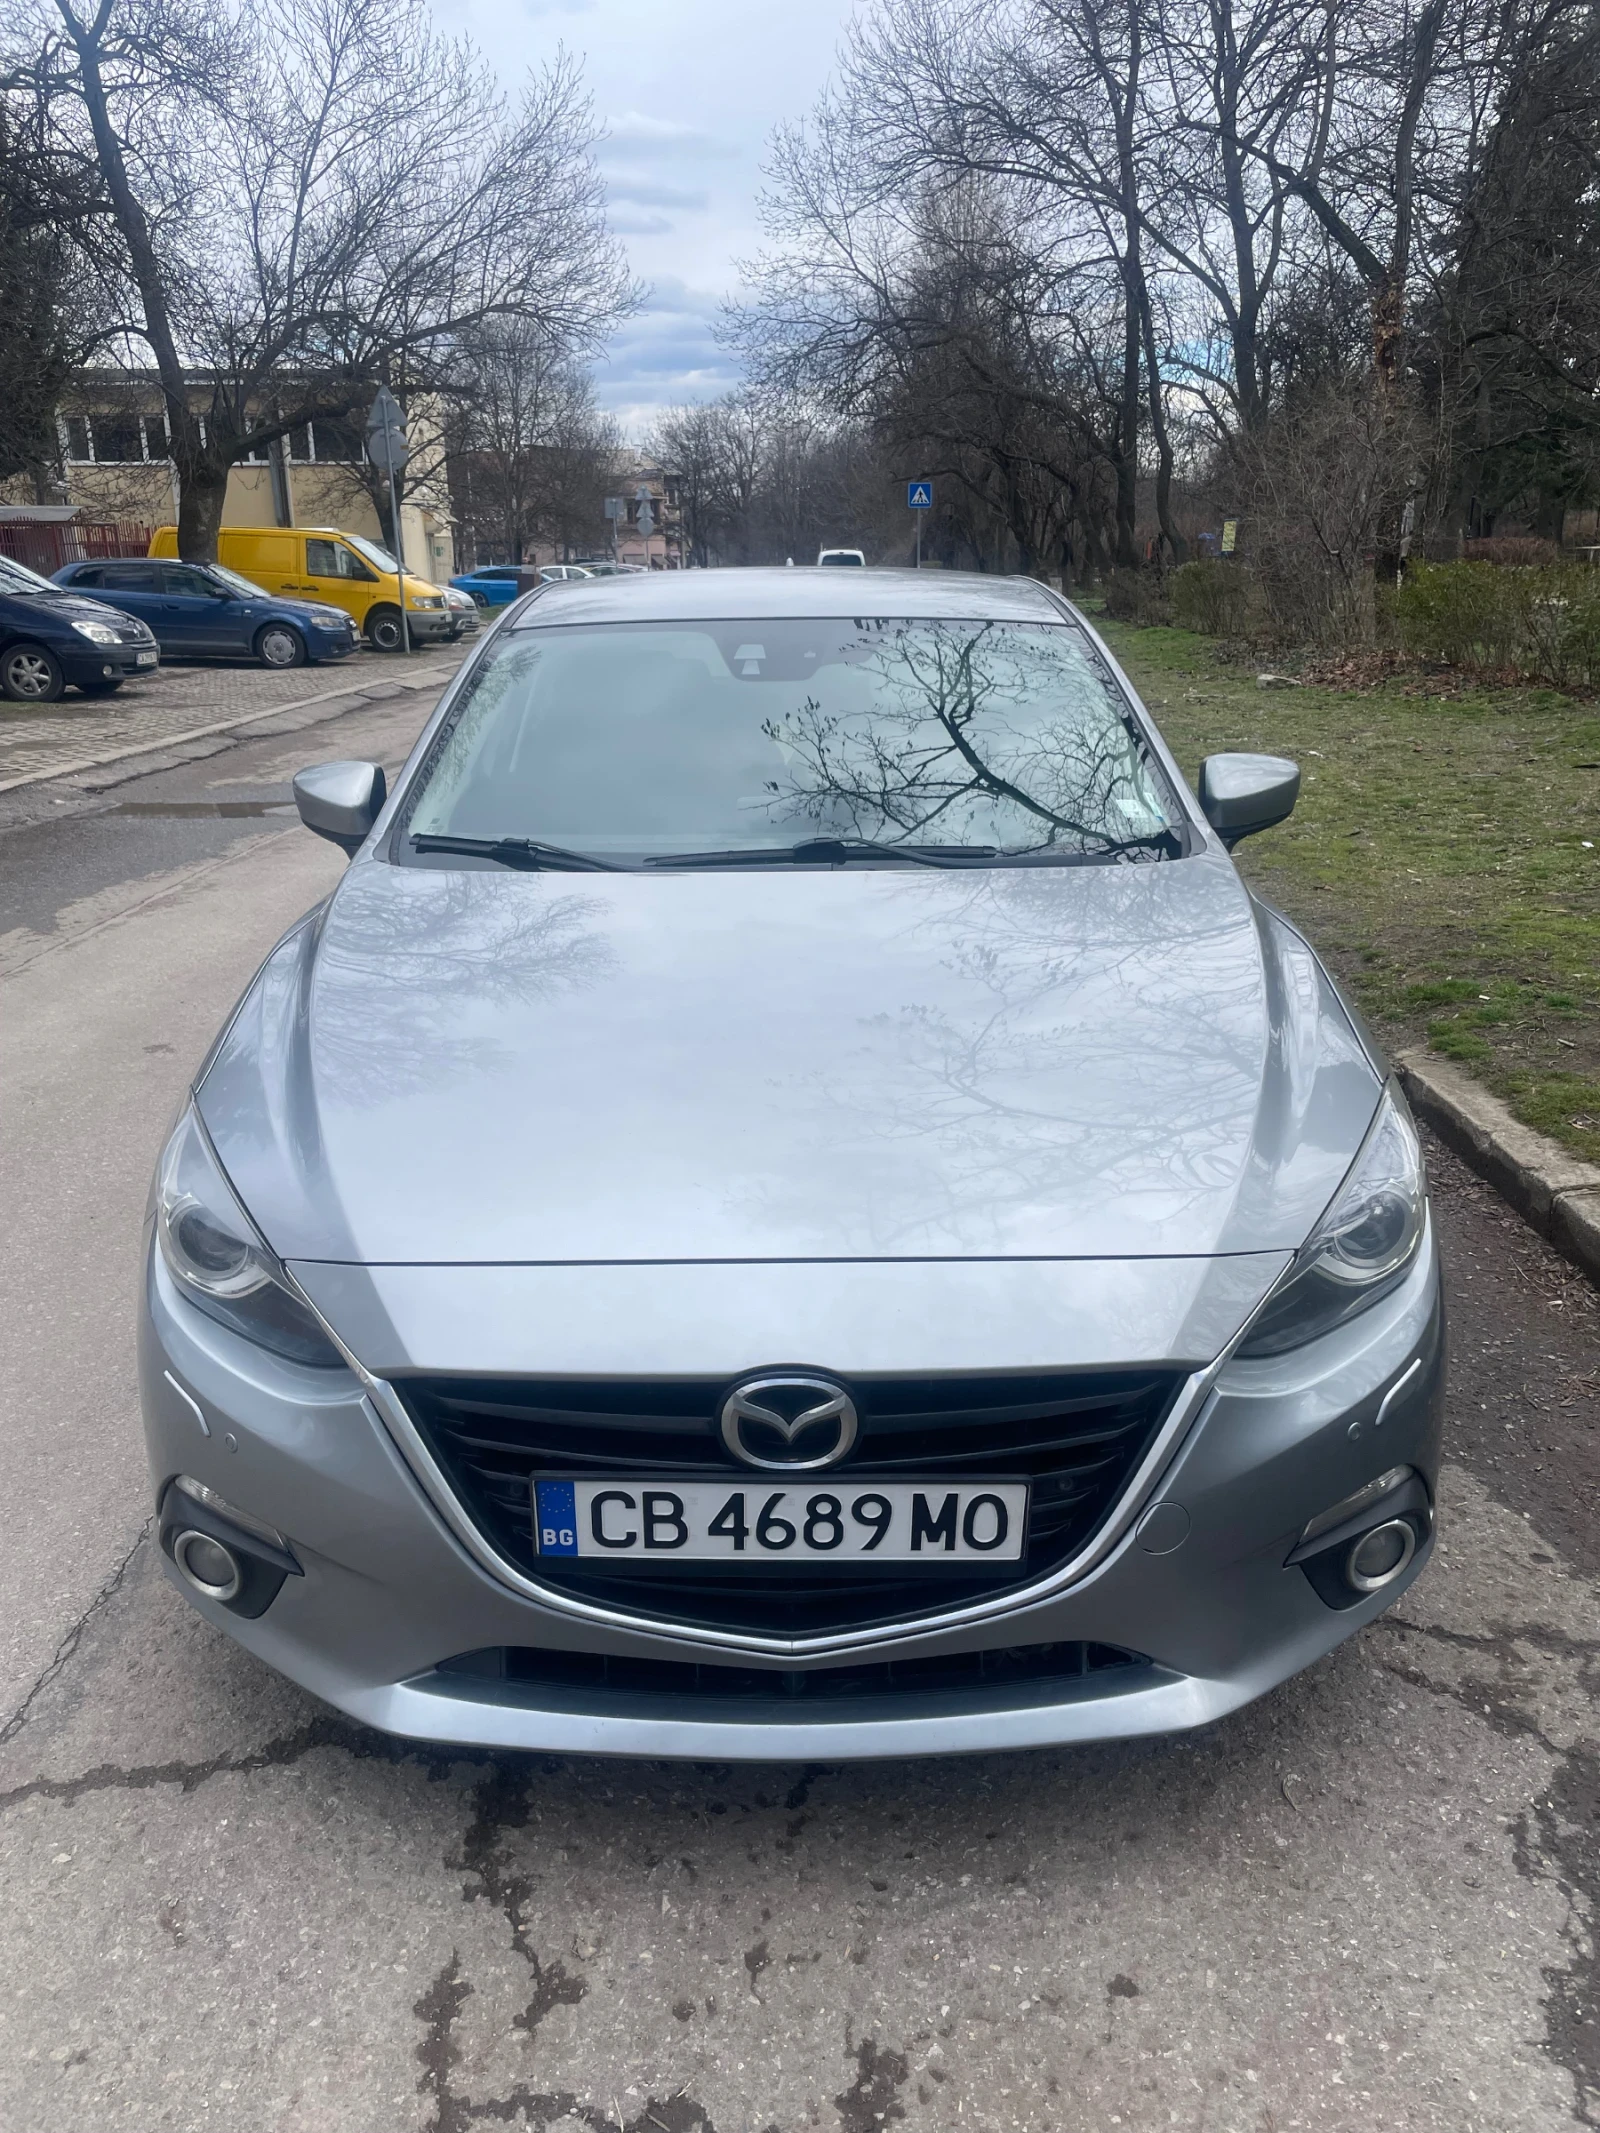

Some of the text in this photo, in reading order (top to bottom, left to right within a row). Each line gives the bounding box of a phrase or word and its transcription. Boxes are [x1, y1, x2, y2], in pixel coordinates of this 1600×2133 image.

[543, 1529, 573, 1545] BG
[591, 1490, 1008, 1550] CB 4689 MO
